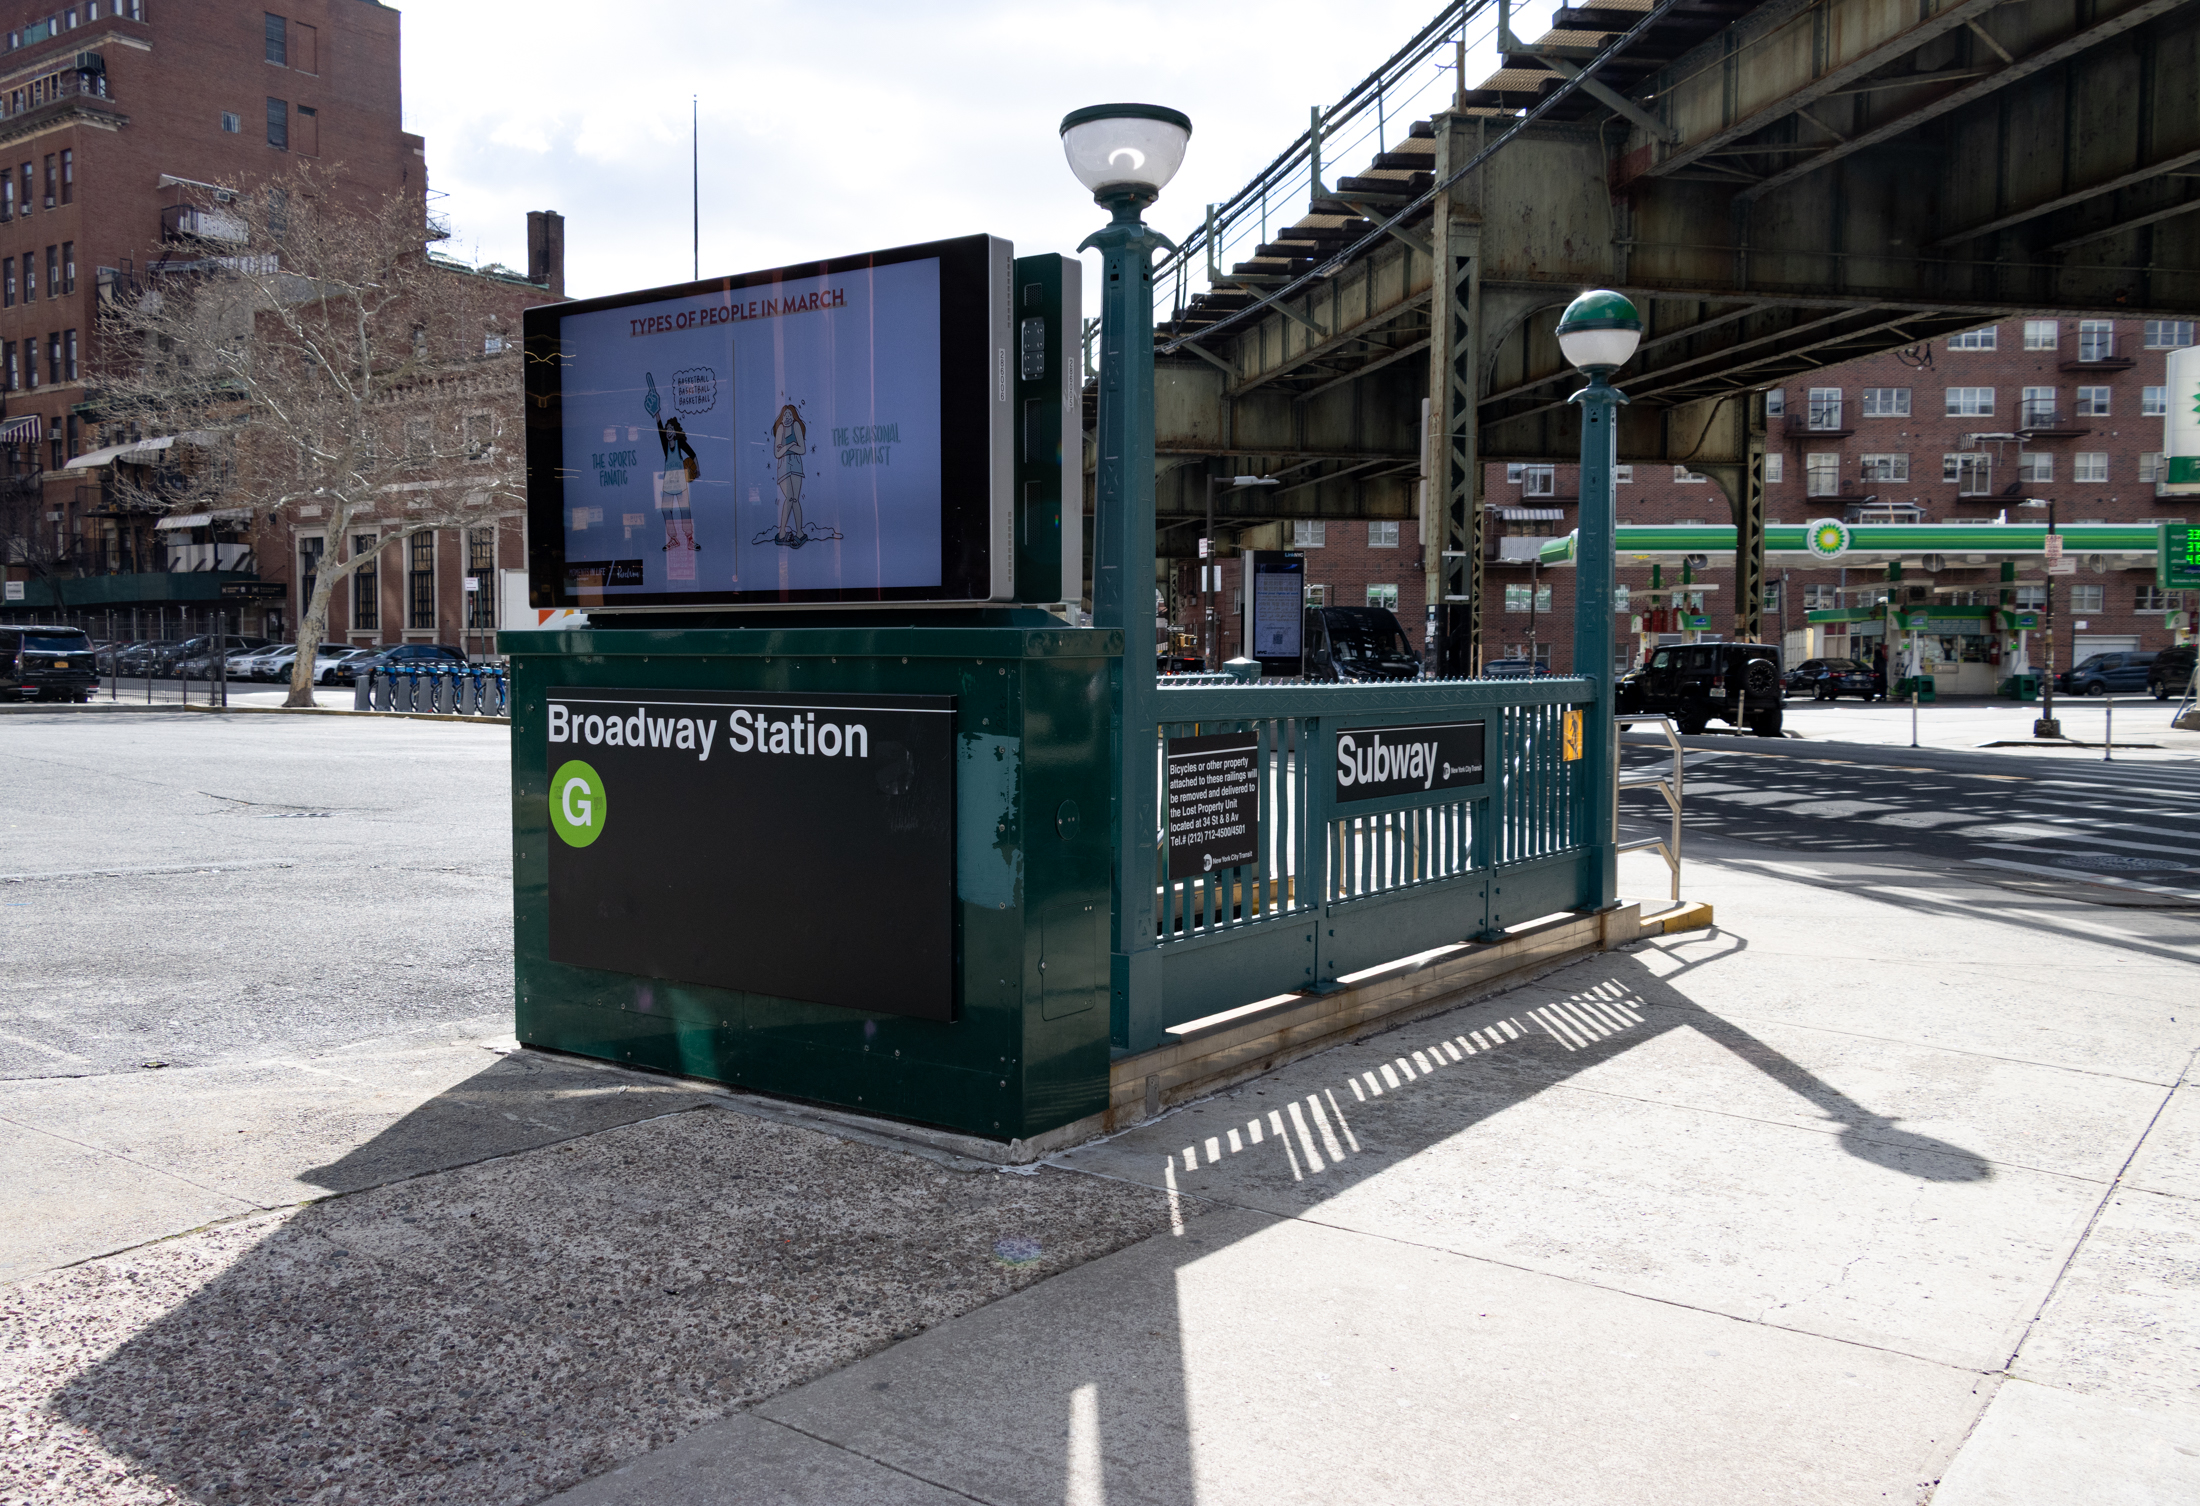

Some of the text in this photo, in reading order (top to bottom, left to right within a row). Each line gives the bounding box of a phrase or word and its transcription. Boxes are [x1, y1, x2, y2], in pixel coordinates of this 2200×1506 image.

[630, 288, 844, 336] TYPES OF PEOPLE IN MARCH
[678, 375, 709, 386] BASKETBALL
[678, 385, 710, 396] BASKETBALL
[679, 395, 710, 406] BASKETBALL
[831, 422, 901, 446] THE SEASONAL
[592, 450, 637, 470] THE SPORTS
[841, 446, 890, 468] OPTIMIST
[600, 469, 628, 486] FANATIC
[596, 568, 606, 576] LIFE
[549, 704, 868, 761] Broadway Station
[1170, 757, 1248, 776] Bicycles or other property
[1337, 734, 1438, 789] Subway
[1170, 768, 1257, 789] attached to these railings will
[562, 778, 592, 826] G
[1170, 783, 1255, 803] be removed and delivered to
[1170, 798, 1238, 818] the Lost Property Unit
[1170, 812, 1239, 832] located at 34 St & 8 Av
[1171, 824, 1246, 846] Tel.# (212) 712-4500/4501
[1239, 850, 1252, 859] Transit
